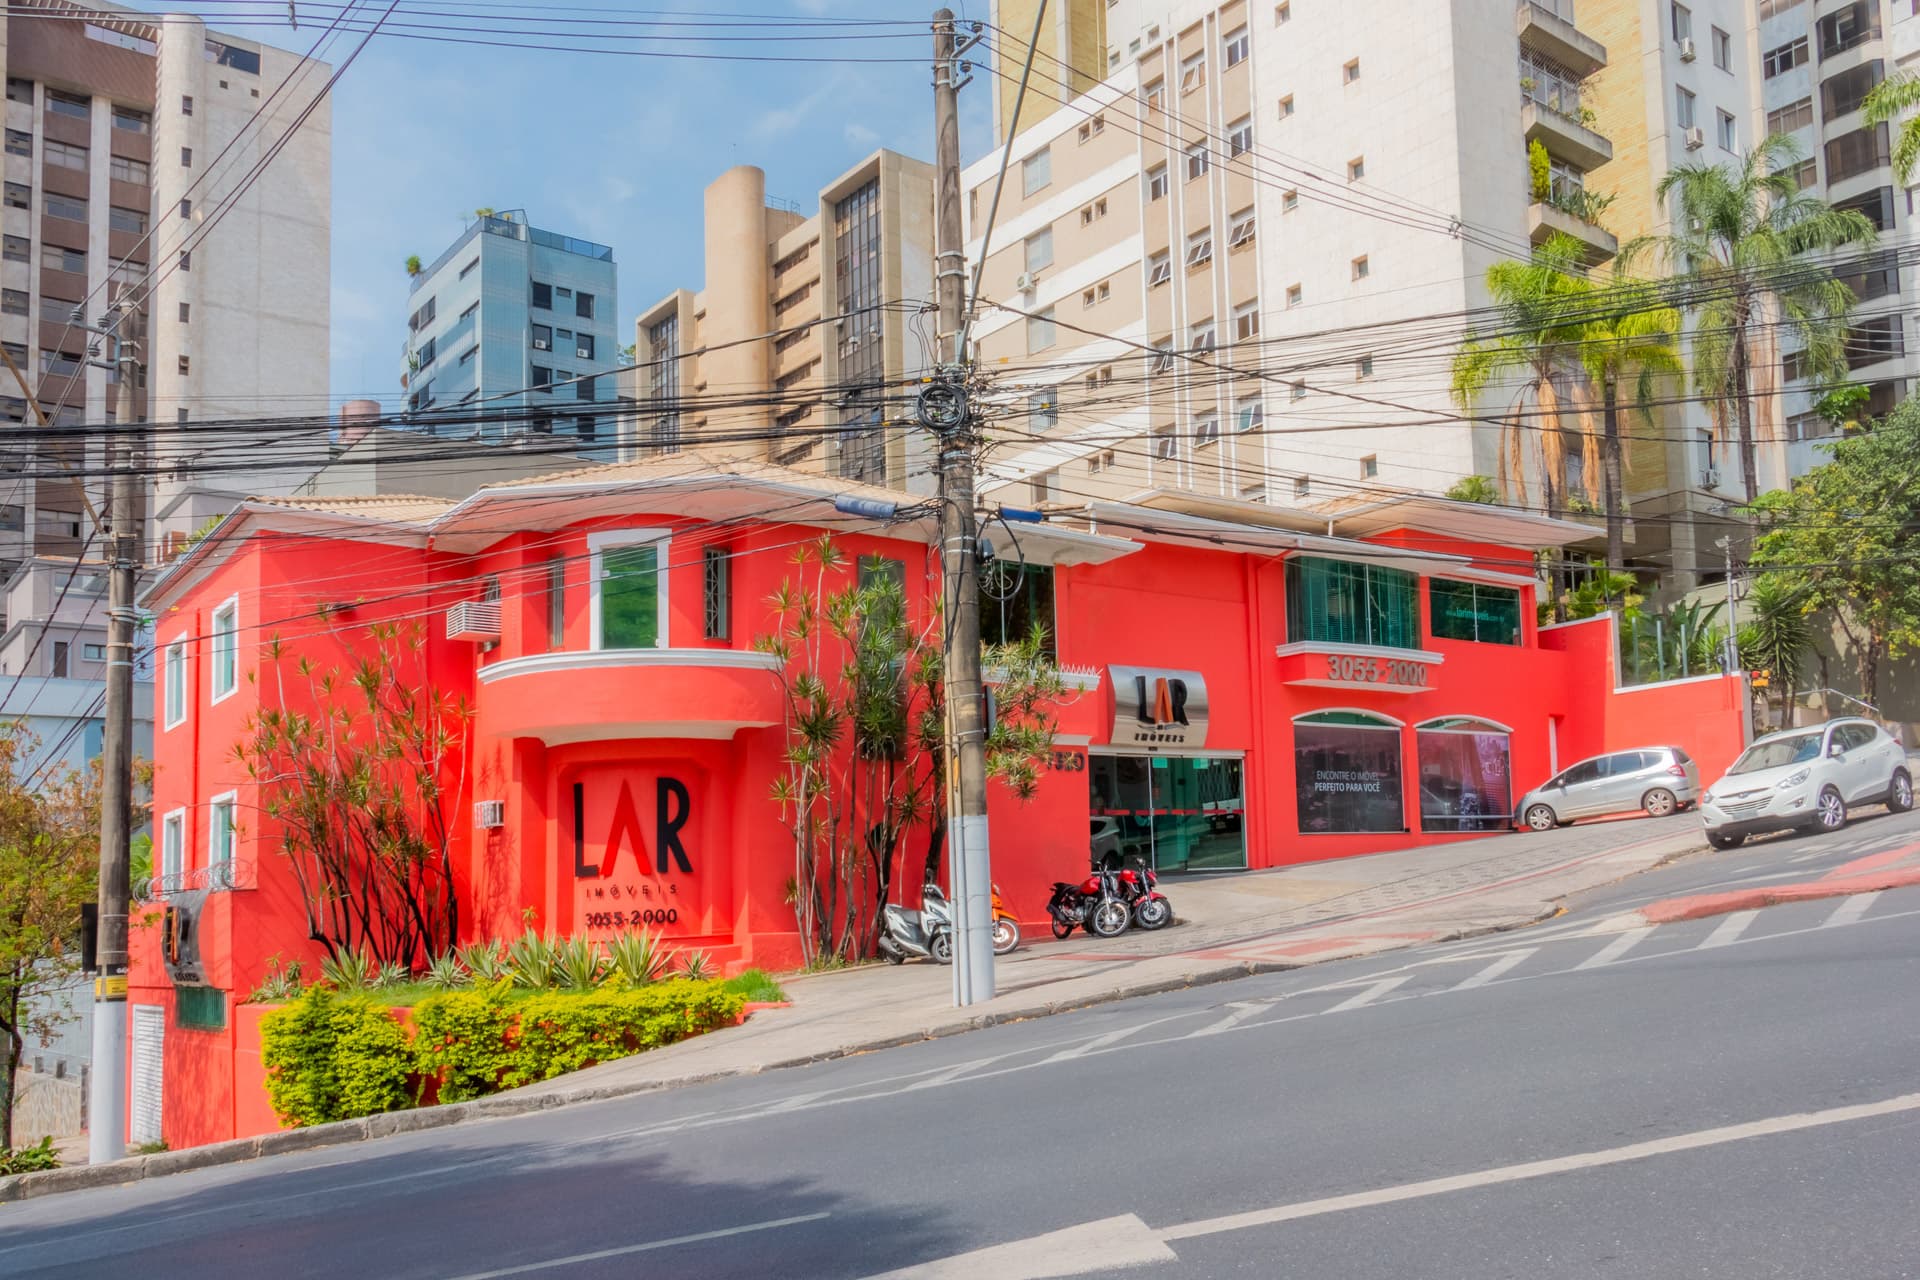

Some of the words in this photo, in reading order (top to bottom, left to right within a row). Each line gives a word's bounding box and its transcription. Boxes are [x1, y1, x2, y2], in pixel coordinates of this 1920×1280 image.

[1327, 656, 1427, 686] 3055-2000
[1135, 675, 1189, 726] LAR
[1315, 782, 1345, 792] PERFEITO
[1346, 783, 1362, 792] PARA
[1363, 781, 1381, 792] VOCÊ
[1316, 770, 1350, 780] ENCONTRE
[574, 776, 693, 878] LAR
[585, 908, 677, 927] 3055-2000
